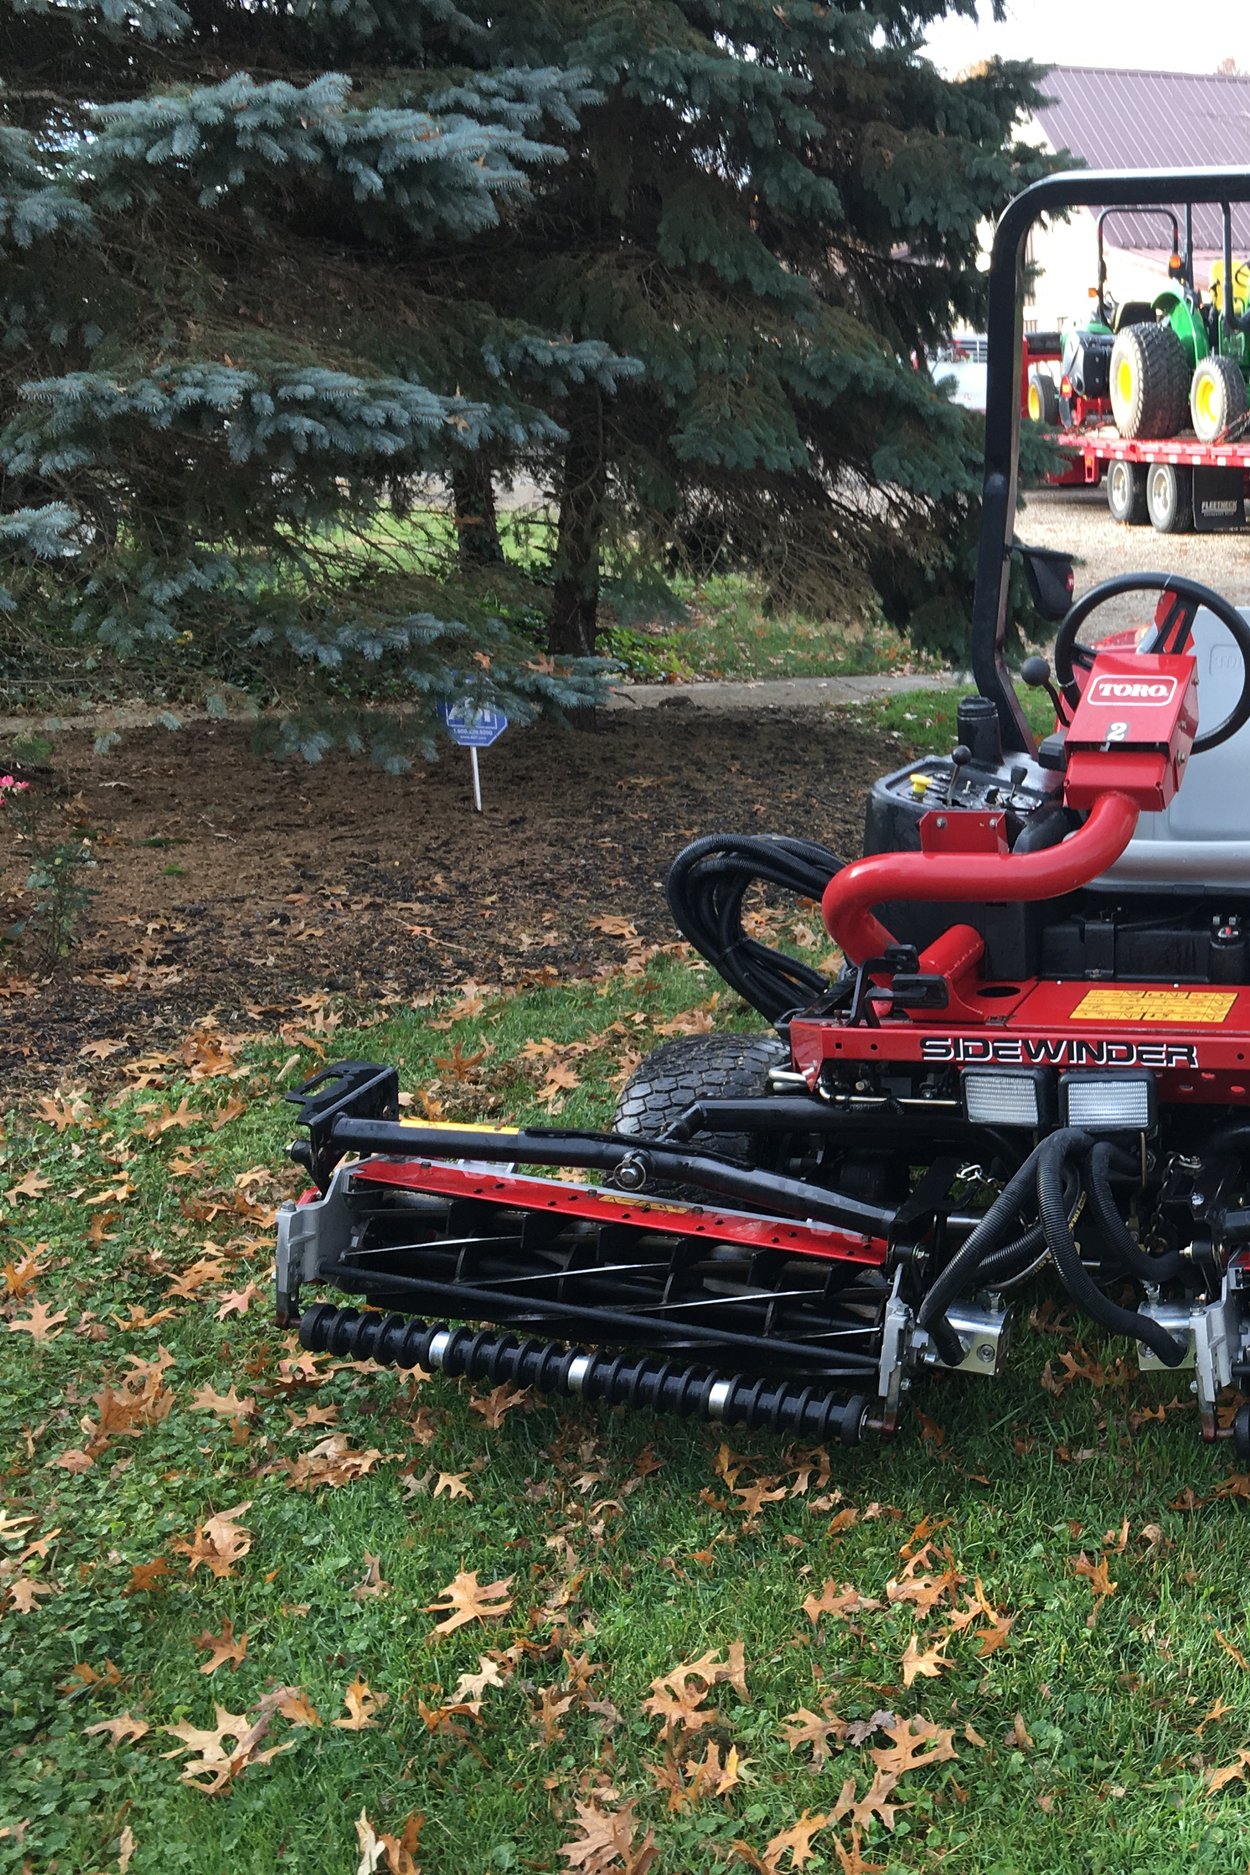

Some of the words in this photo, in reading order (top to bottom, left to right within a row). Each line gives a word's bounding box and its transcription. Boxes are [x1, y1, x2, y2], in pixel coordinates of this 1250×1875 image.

[1099, 683, 1168, 697] TORO
[1107, 722, 1127, 741] 2
[920, 1037, 1199, 1068] SIDEWINDER
